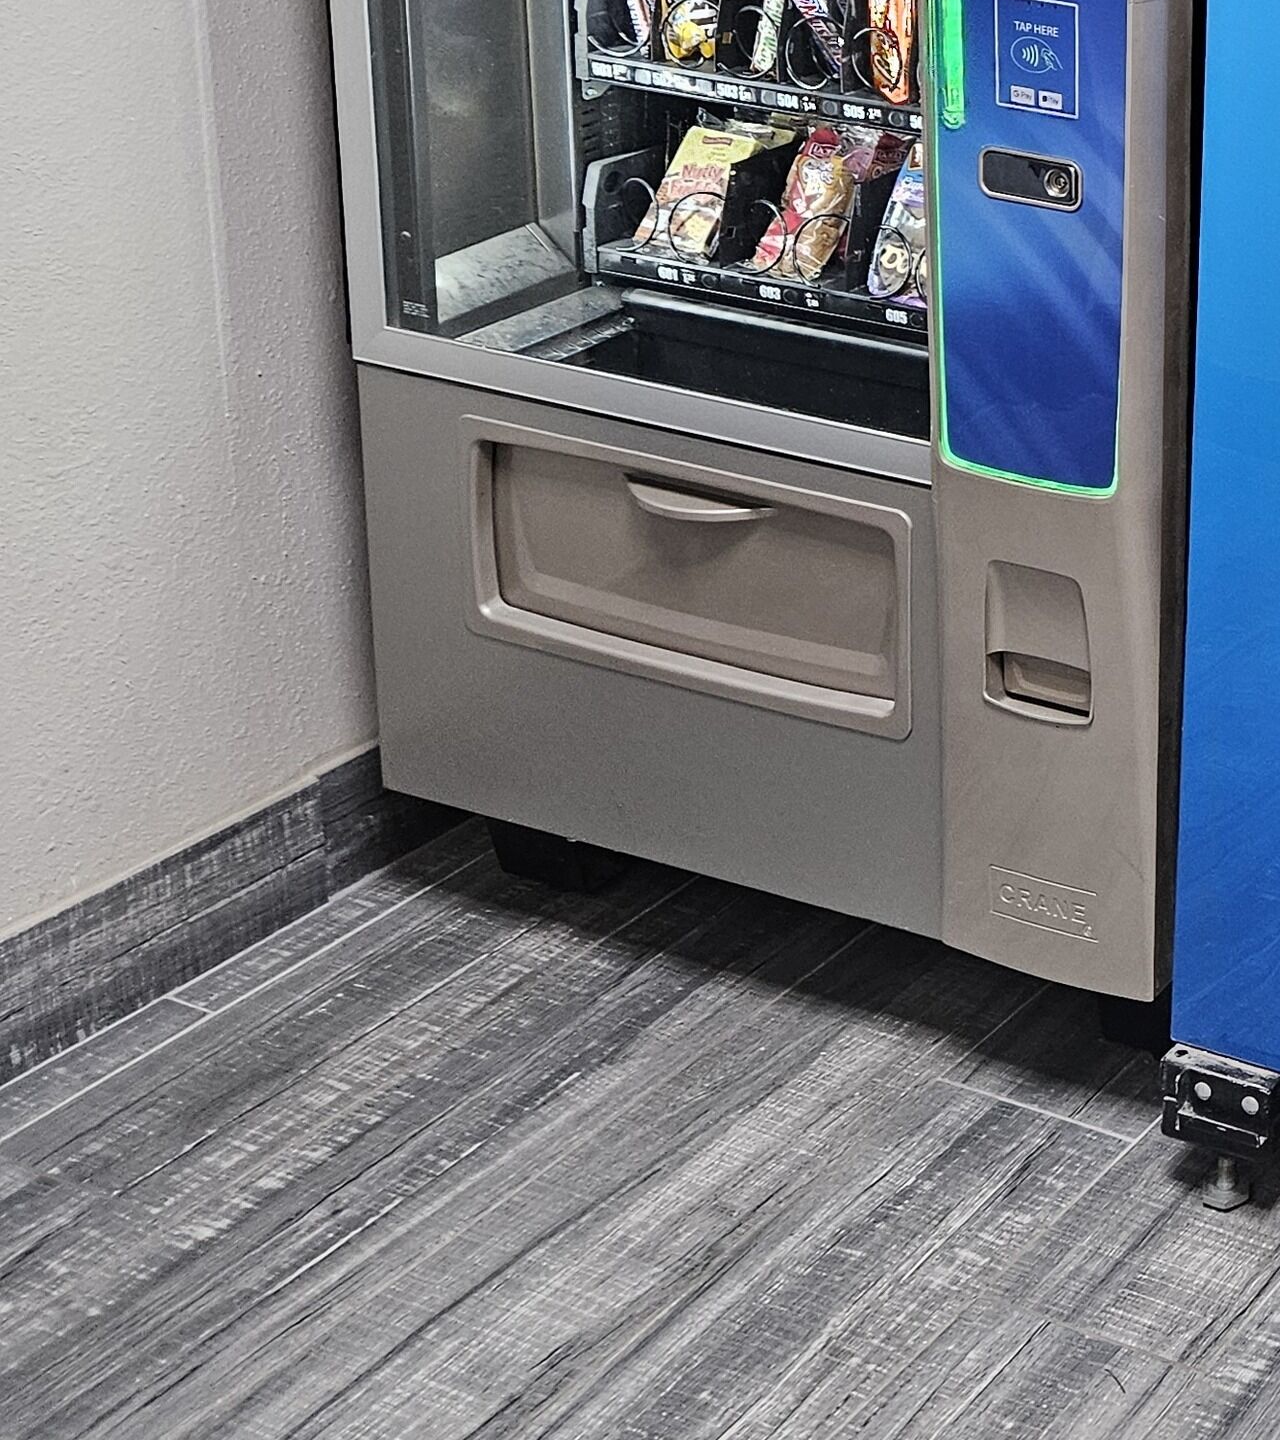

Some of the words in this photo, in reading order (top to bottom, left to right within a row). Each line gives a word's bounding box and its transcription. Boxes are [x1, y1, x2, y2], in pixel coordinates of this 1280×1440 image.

[1013, 20, 1033, 33] TAP
[1034, 24, 1060, 38] HERE
[1000, 883, 1087, 925] CRANE
